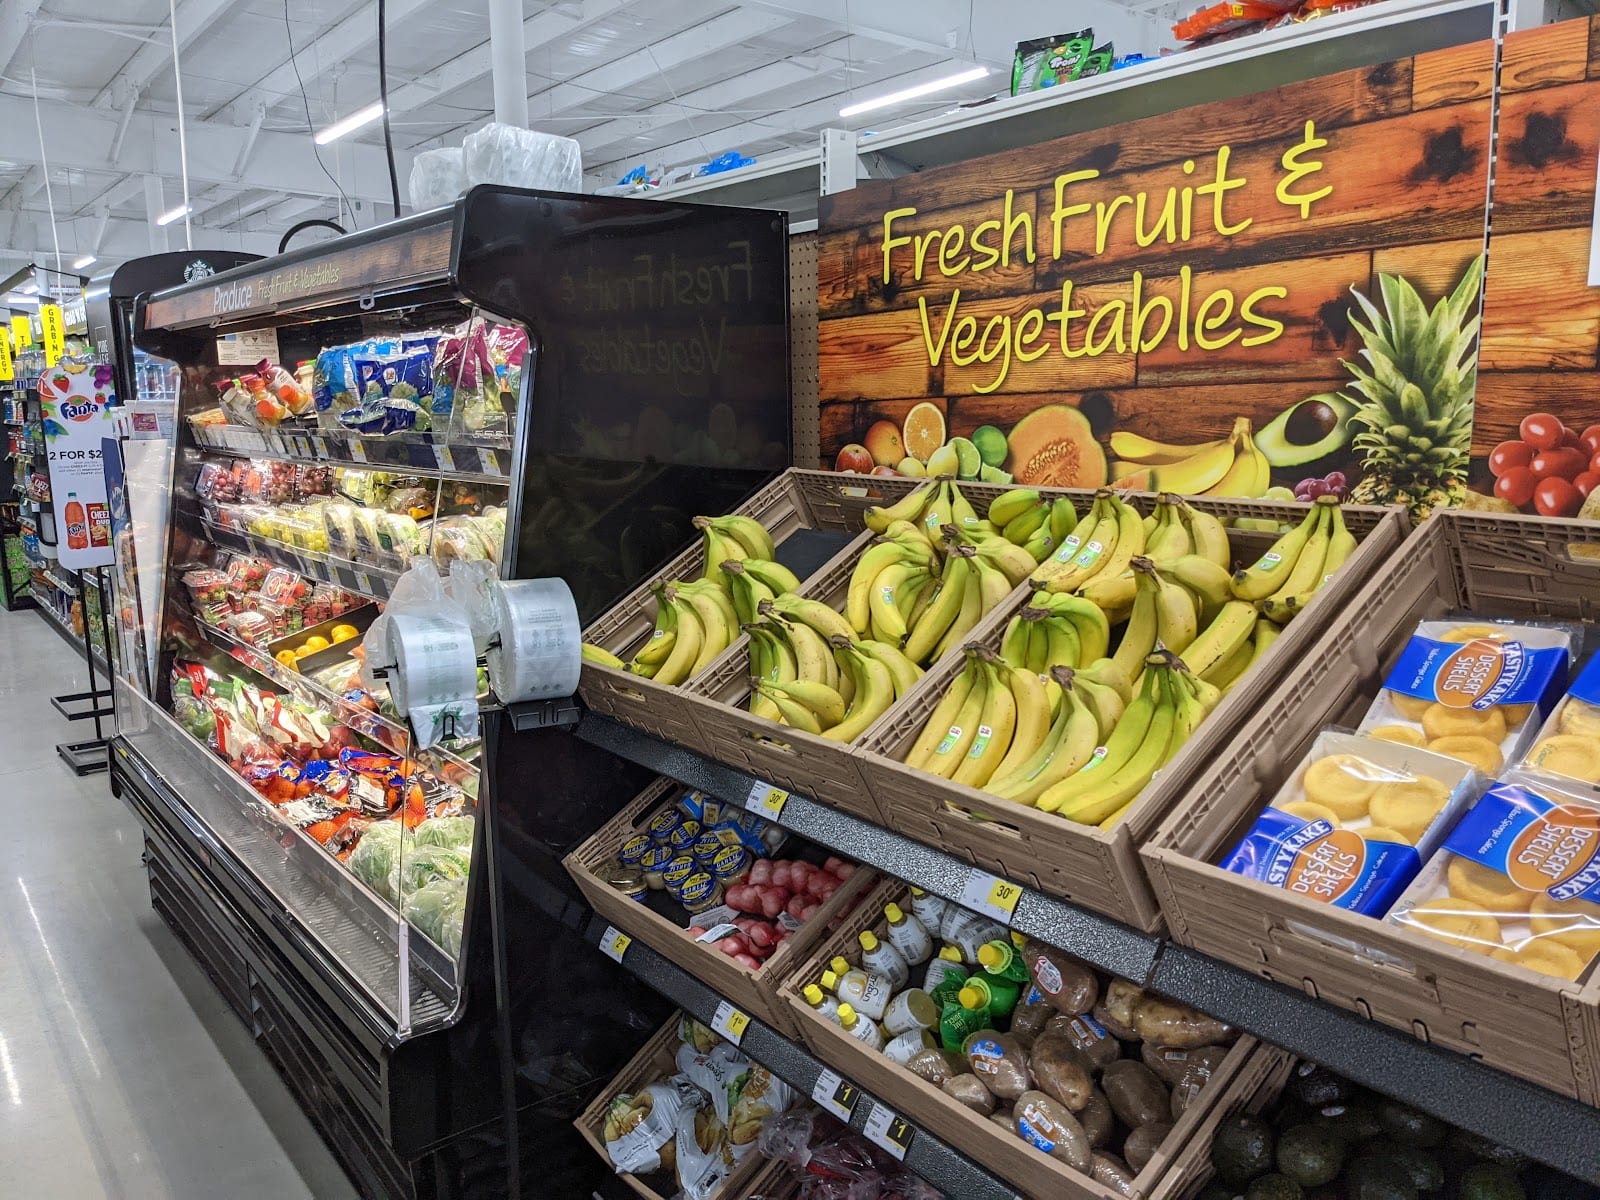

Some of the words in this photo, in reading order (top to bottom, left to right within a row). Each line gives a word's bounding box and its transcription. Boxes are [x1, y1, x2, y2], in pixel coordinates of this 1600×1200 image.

[881, 190, 1036, 285] Fresh
[1051, 145, 1253, 260] Fruit
[1275, 119, 1333, 220] &
[214, 283, 253, 313] Produce
[918, 266, 1287, 394] Vegetables
[60, 401, 99, 420] Fanta
[49, 451, 57, 461] 2
[60, 450, 85, 460] FOR
[1442, 656, 1475, 692] SHELLS
[1460, 654, 1497, 697] DESSERT
[1473, 640, 1522, 710] TASTYKAKE
[1477, 836, 1498, 855] Cakes
[1491, 817, 1514, 840] Sponge
[1518, 823, 1566, 866] SHELLS
[1291, 841, 1340, 894] DESSERT
[1314, 853, 1358, 897] SHELLS
[1359, 870, 1378, 894] Sponge
[1372, 851, 1389, 871] Cakes
[1538, 827, 1593, 880] DESSERT
[996, 884, 1015, 900] 30¢
